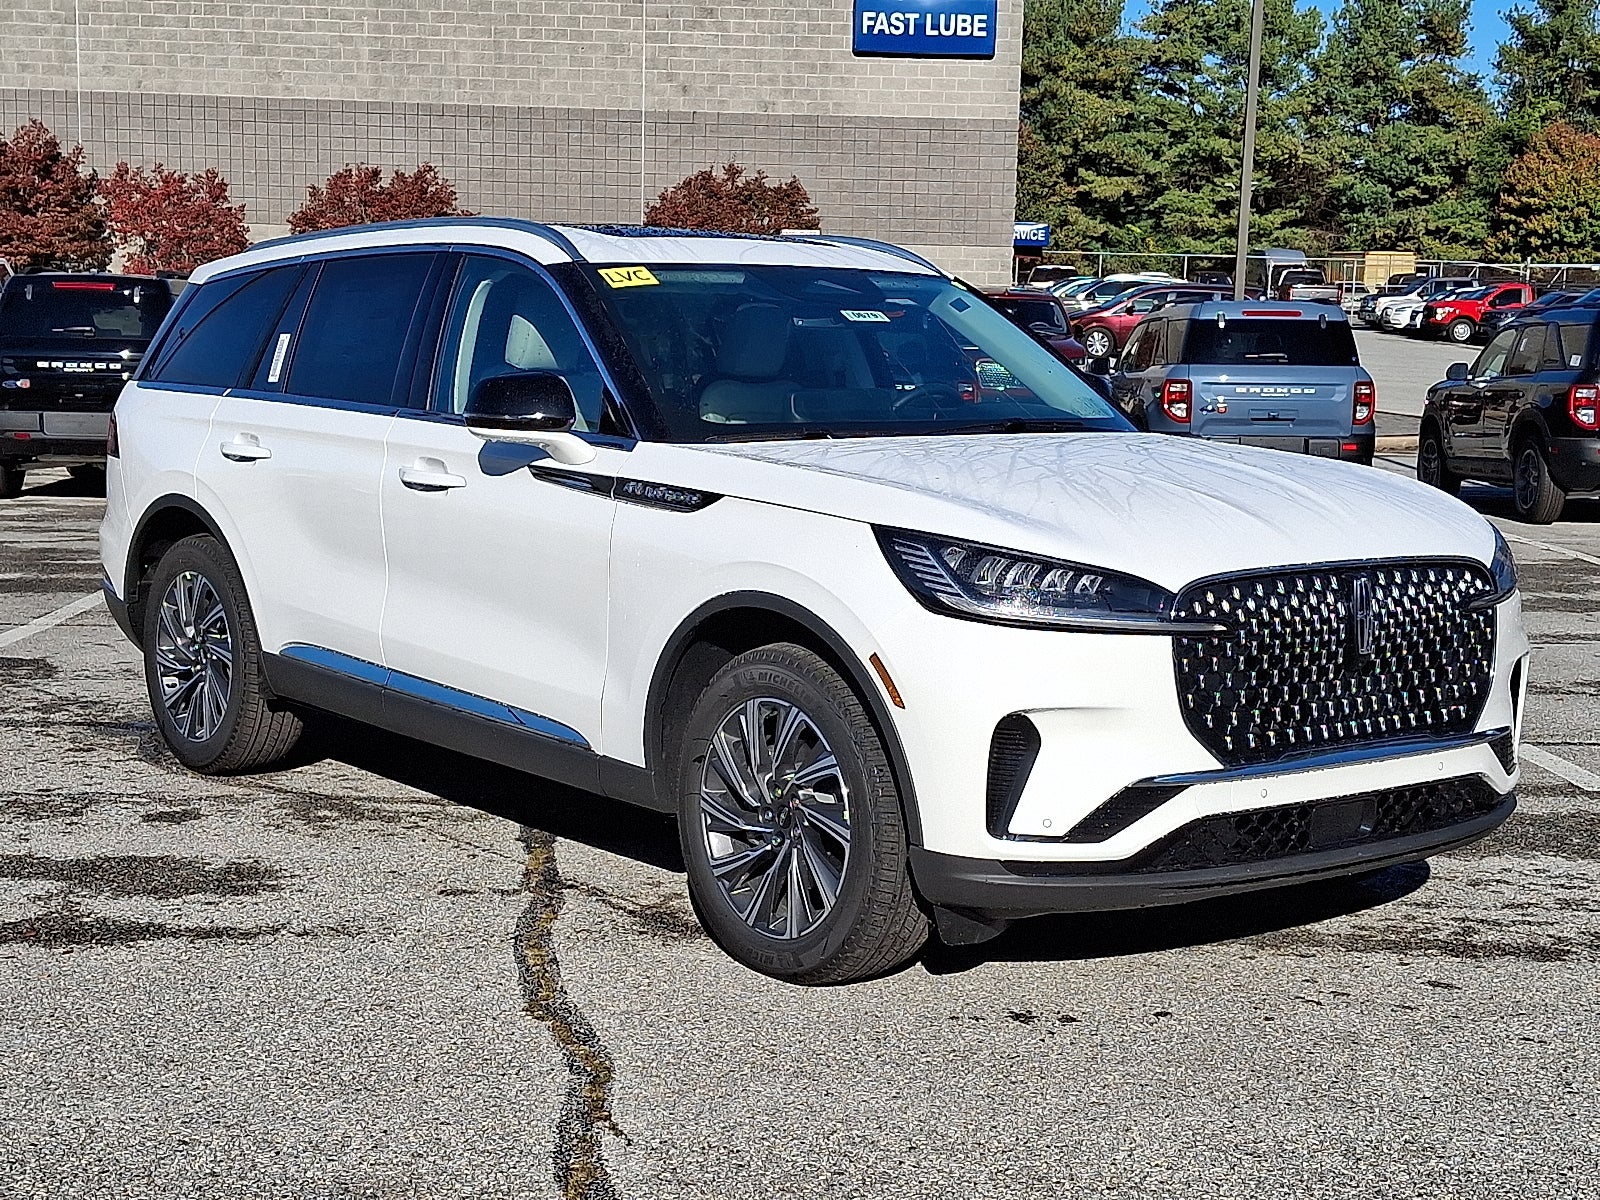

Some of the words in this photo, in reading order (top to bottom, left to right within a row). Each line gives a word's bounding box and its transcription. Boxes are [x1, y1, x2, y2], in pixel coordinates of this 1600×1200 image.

[862, 11, 919, 35] FAST
[925, 13, 988, 37] LUBE
[604, 269, 651, 283] LVC
[36, 361, 122, 370] BRONCO
[1235, 386, 1316, 394] BRONCO
